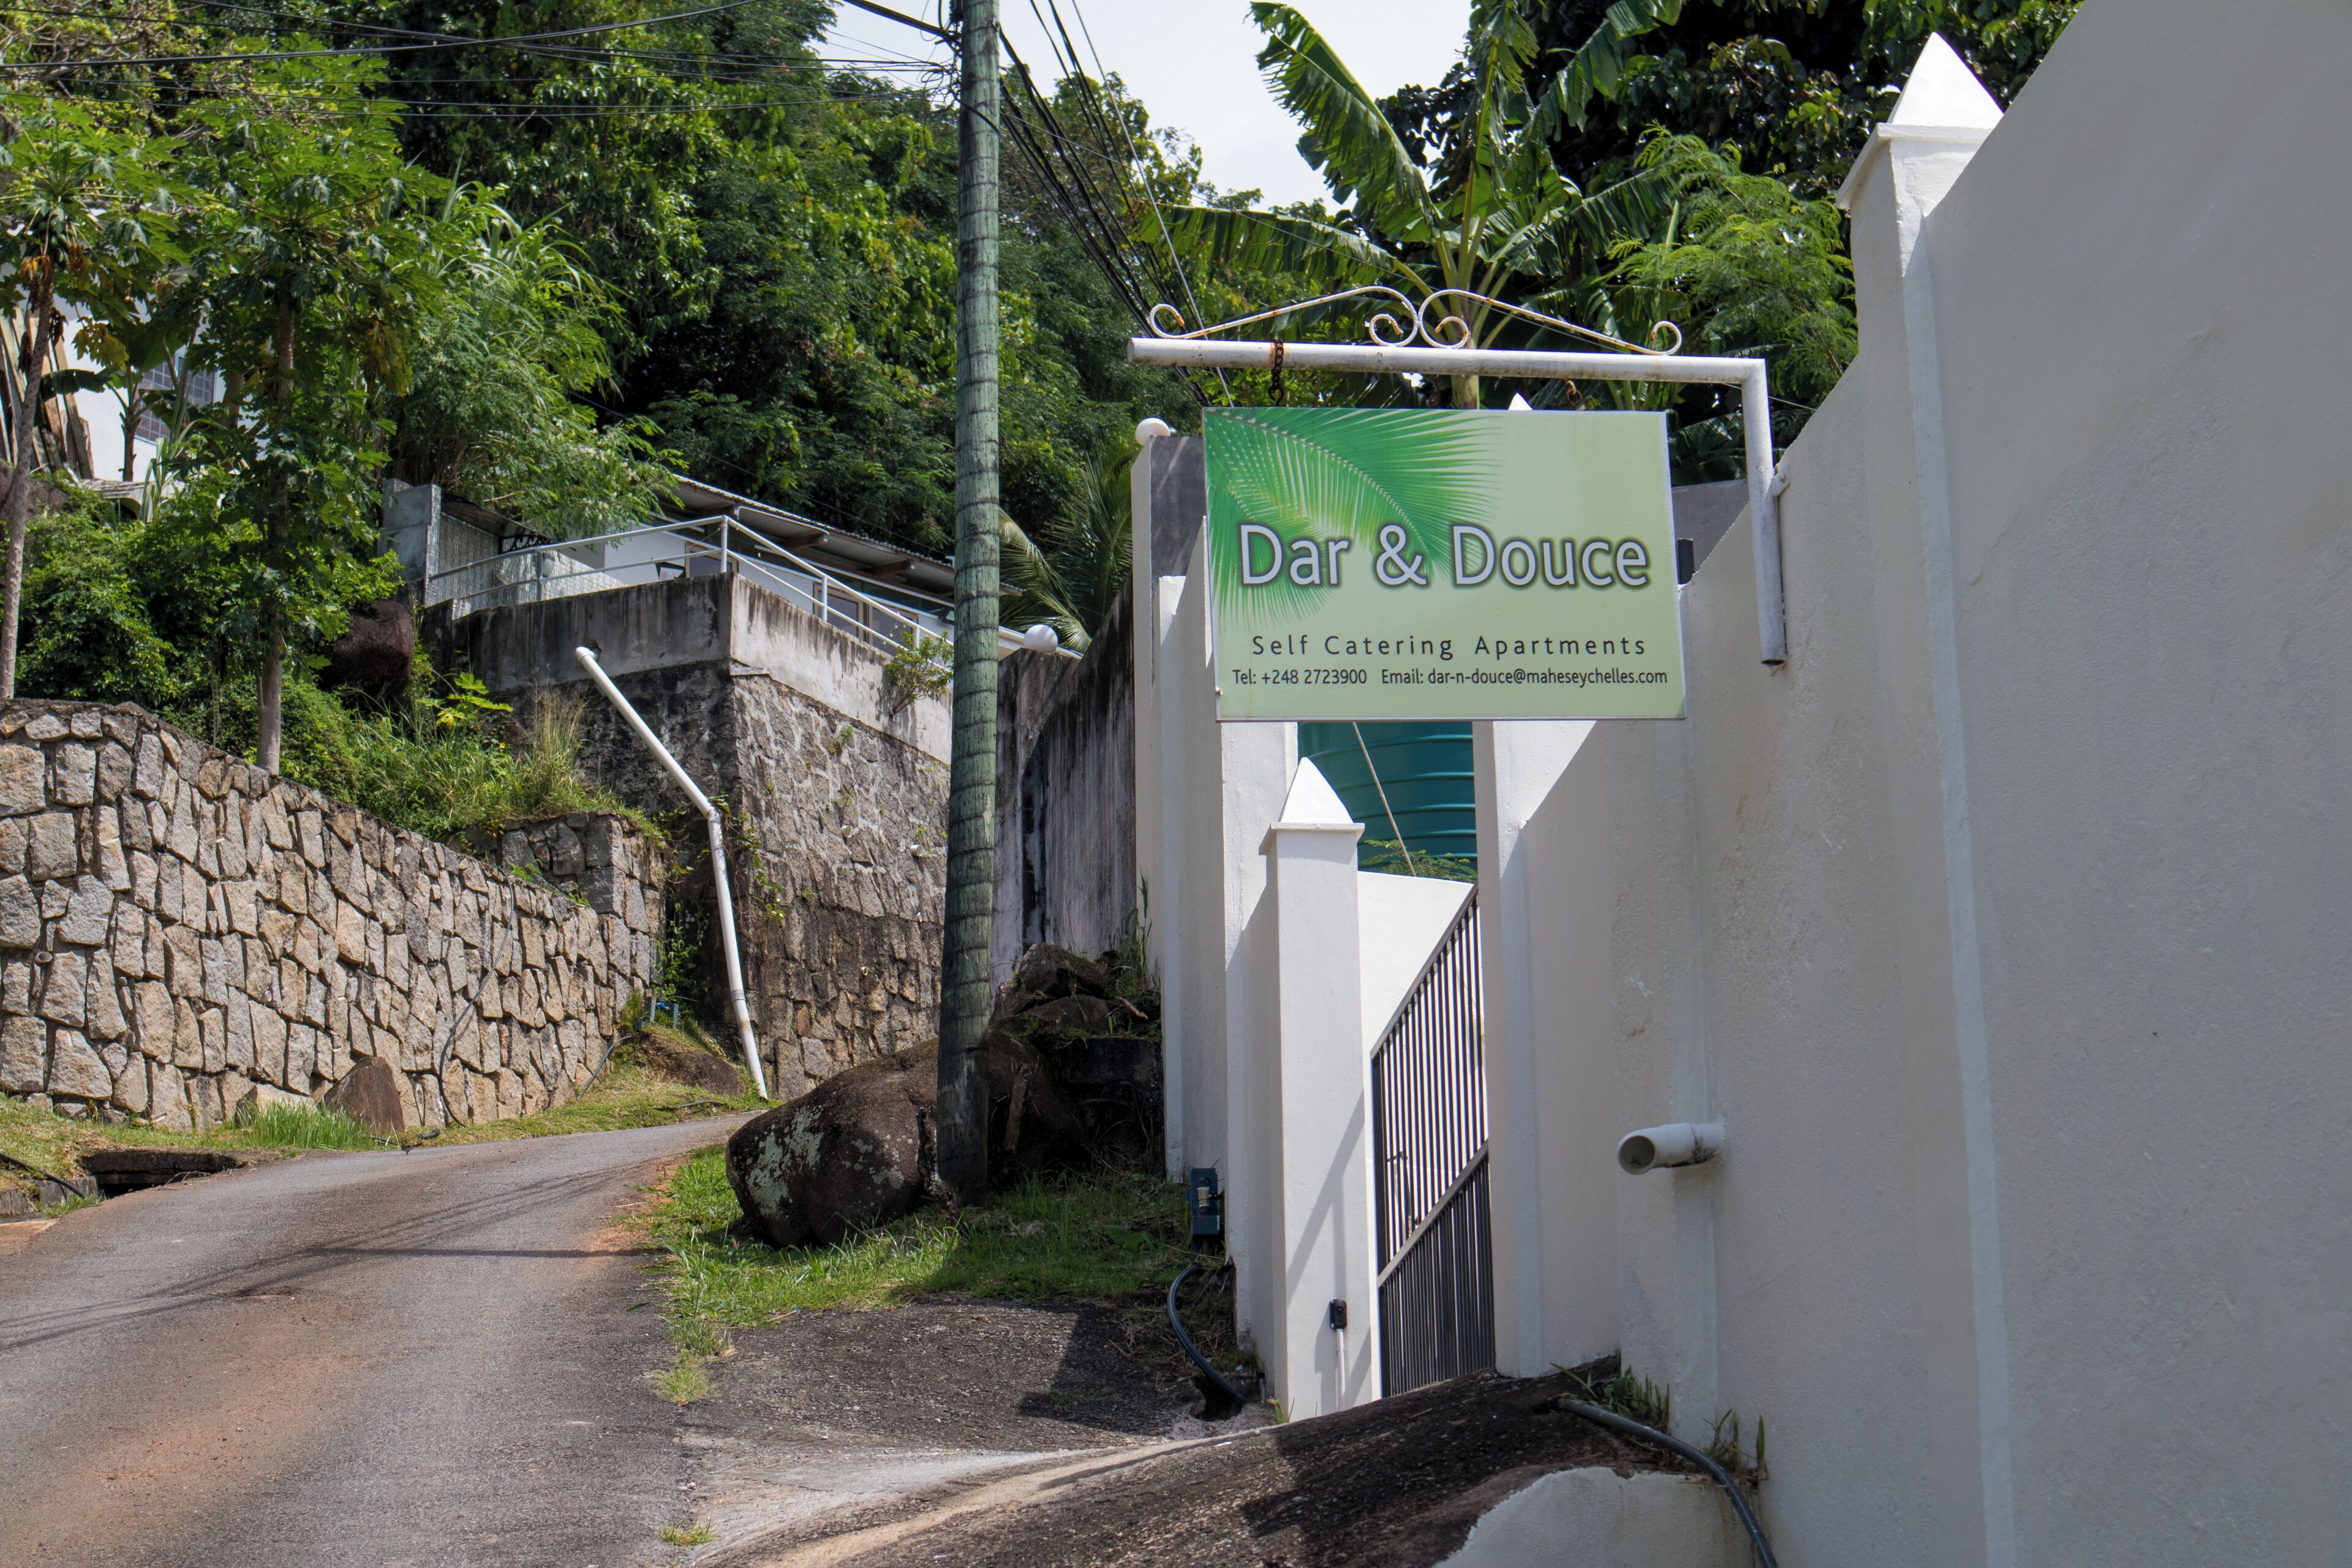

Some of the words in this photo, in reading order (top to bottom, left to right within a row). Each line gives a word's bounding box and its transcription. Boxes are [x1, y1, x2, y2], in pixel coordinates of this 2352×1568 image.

[1239, 523, 1350, 586] Dar
[1374, 523, 1428, 586] &
[1451, 524, 1649, 587] Douce
[1252, 635, 1308, 655] Self
[1324, 635, 1453, 660] Catering
[1474, 635, 1645, 660] Apartments
[1232, 668, 1256, 684] Tel:
[1261, 669, 1298, 684] +248
[1304, 669, 1367, 684] 2723900
[1381, 668, 1423, 684] Email:
[1428, 668, 1668, 688] dar-n-douce@maheseychelles.com
